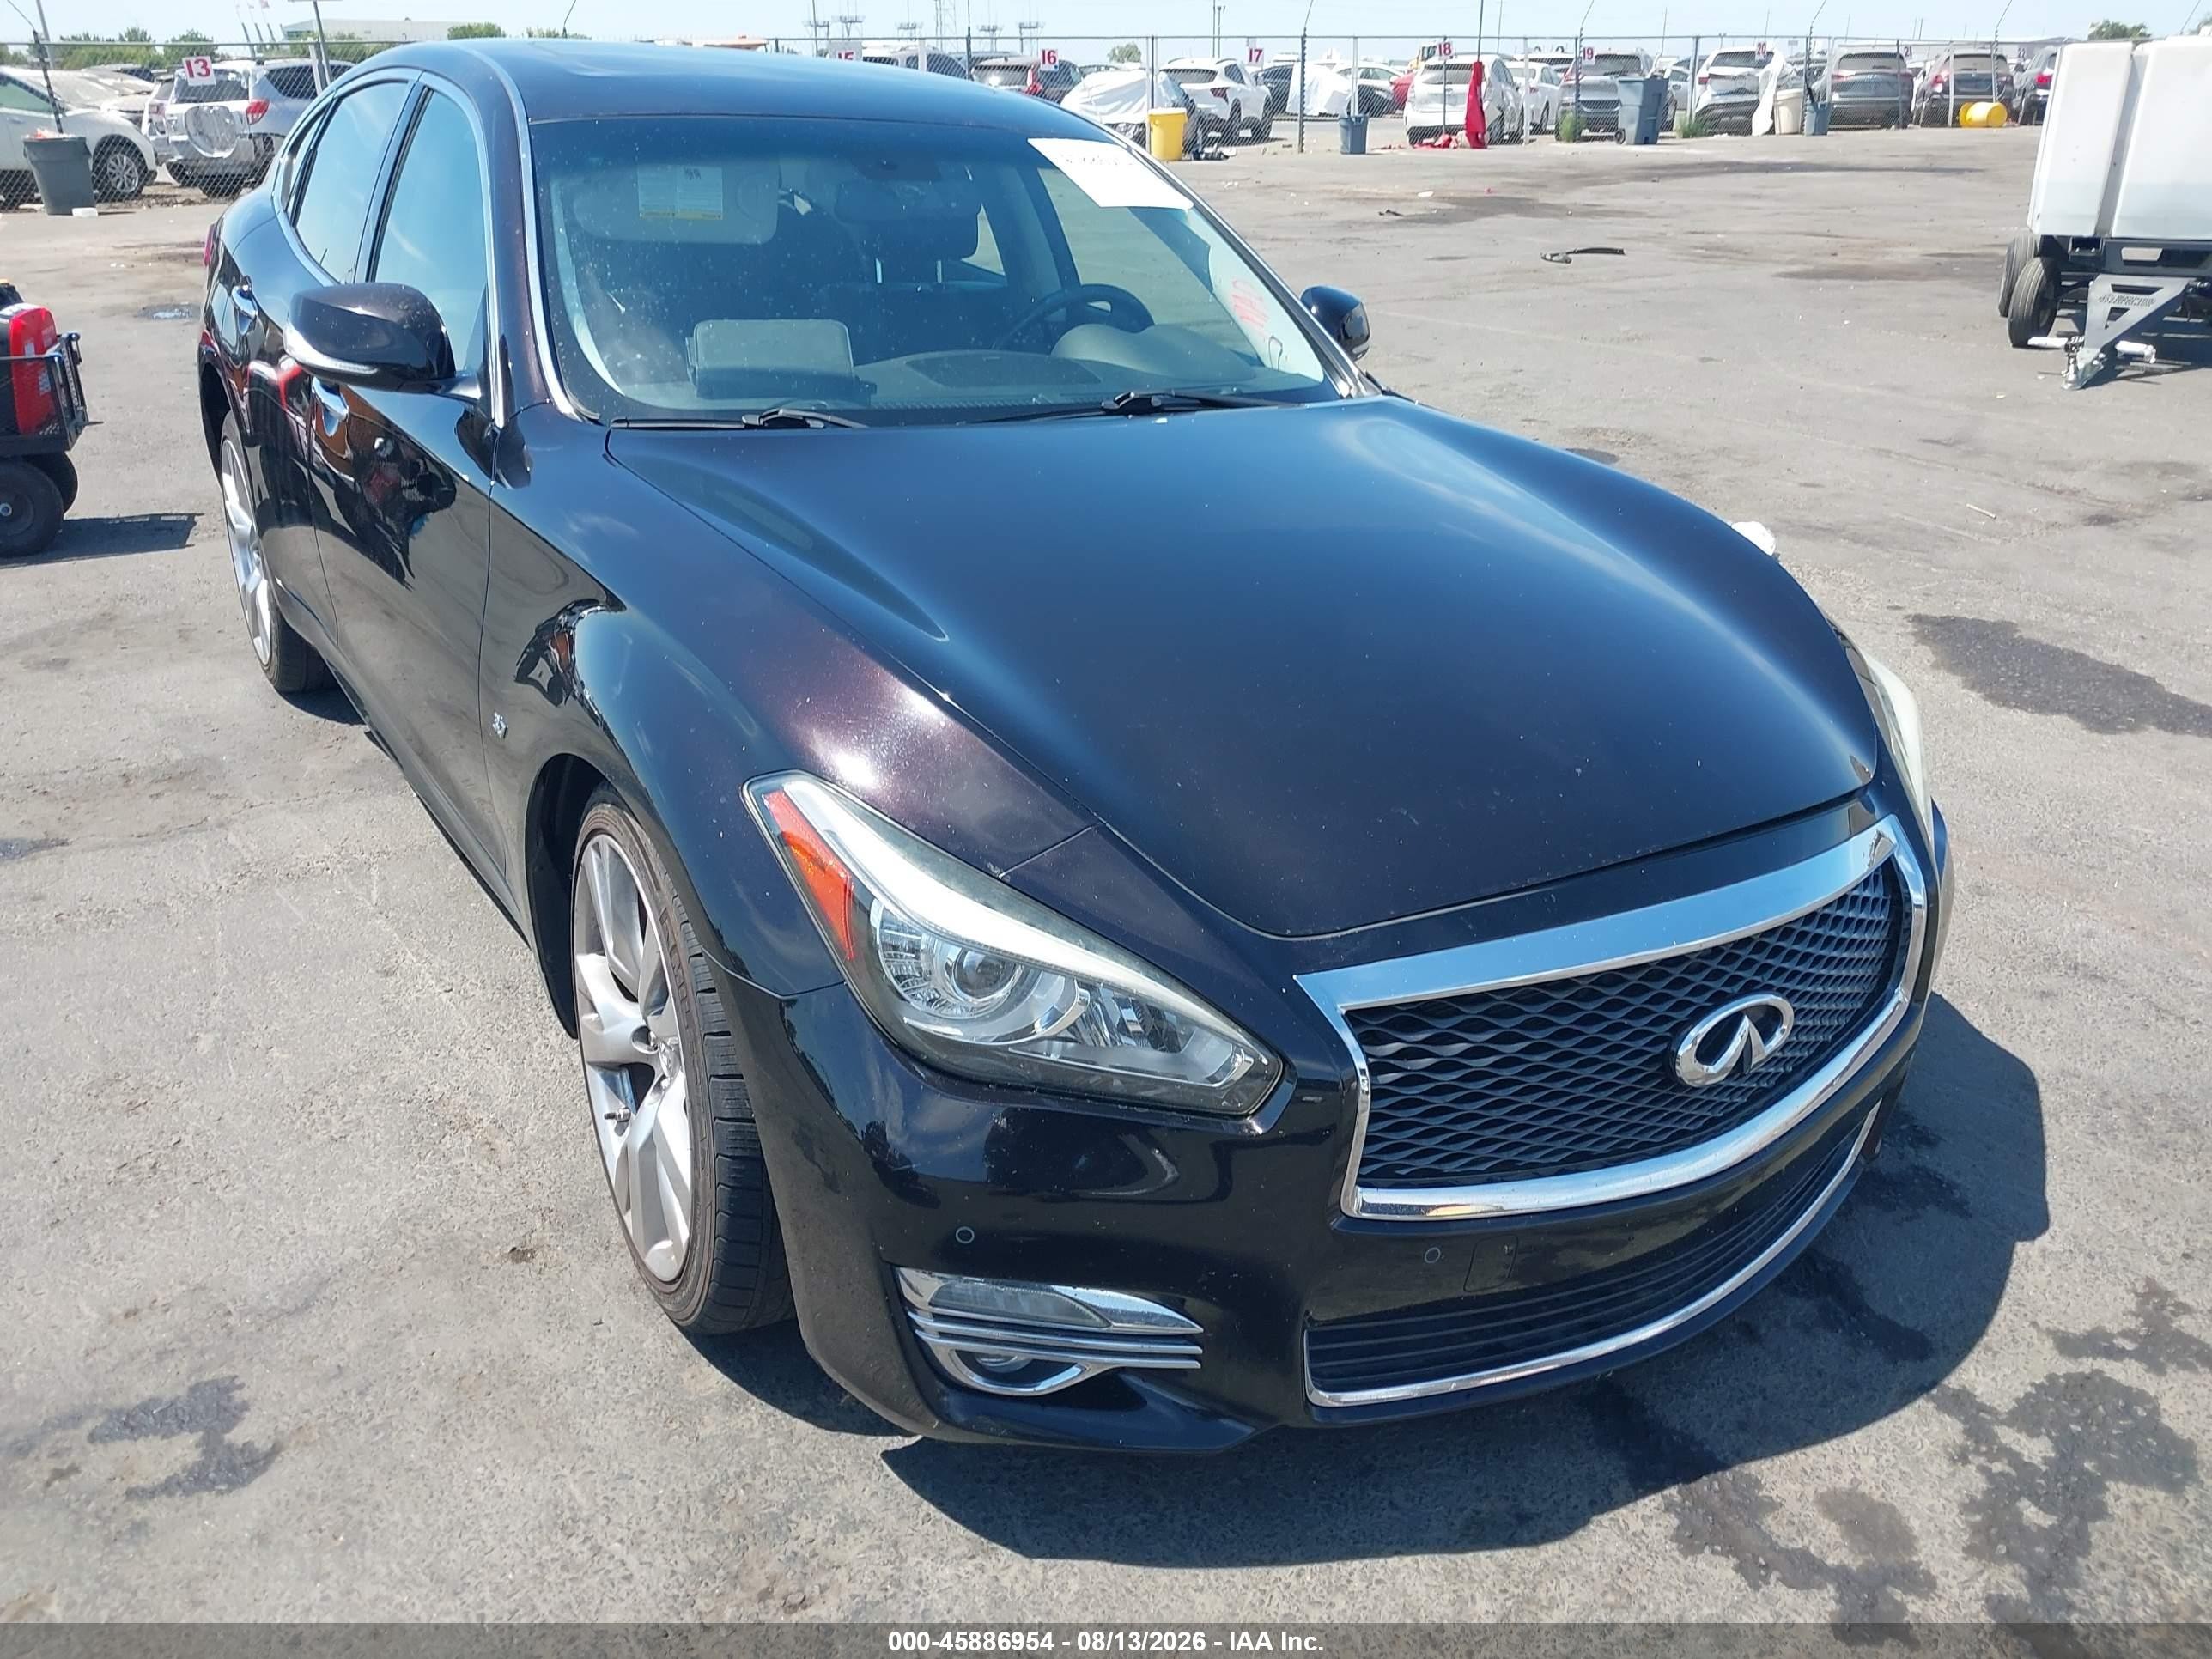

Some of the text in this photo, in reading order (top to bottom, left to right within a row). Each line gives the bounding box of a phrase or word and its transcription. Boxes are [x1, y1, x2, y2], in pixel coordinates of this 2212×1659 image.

[1249, 48, 1263, 63] 17
[1438, 42, 1452, 56] 18
[1583, 47, 1595, 60] 19
[1757, 42, 1766, 55] 20
[1904, 46, 1912, 57] 21
[1042, 49, 1057, 65] 16
[185, 58, 211, 79] 13
